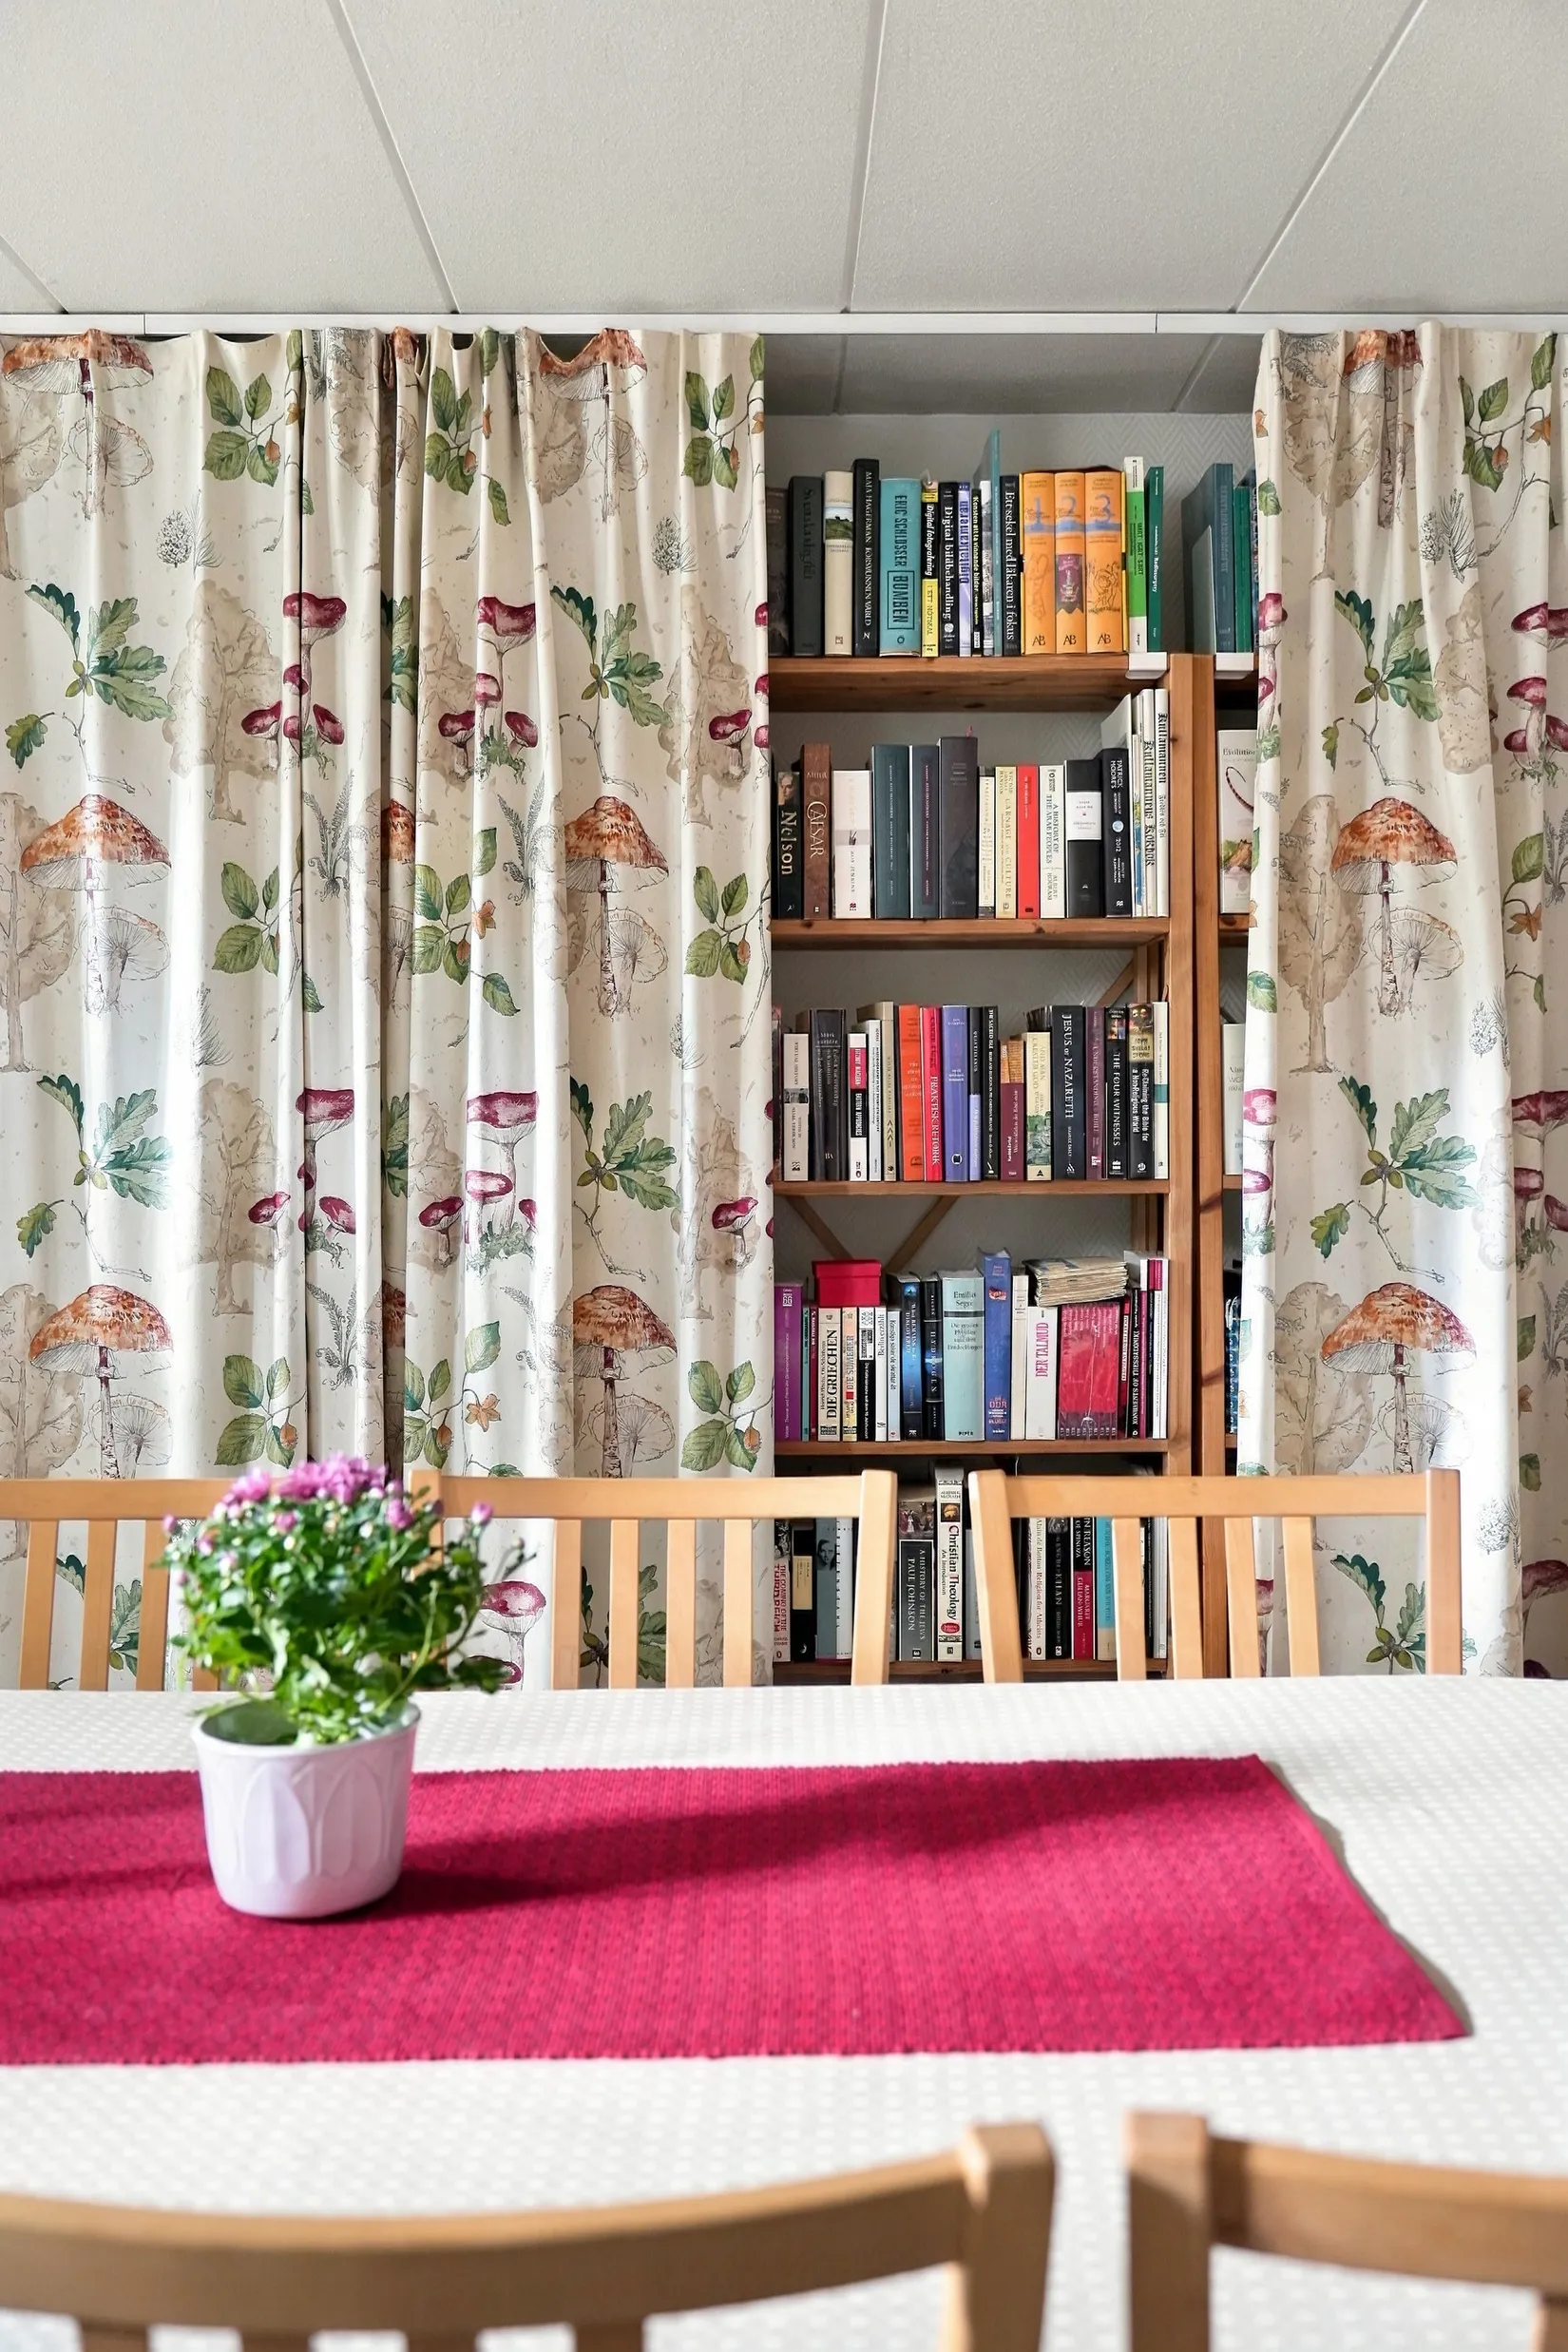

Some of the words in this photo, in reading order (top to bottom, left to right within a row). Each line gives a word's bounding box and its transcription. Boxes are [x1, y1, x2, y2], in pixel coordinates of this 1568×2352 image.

[894, 495, 908, 514] ERIC
[925, 504, 935, 528] Digital
[1004, 491, 1016, 507] Ett
[864, 495, 872, 543] HAGERMAN
[942, 507, 953, 541] Digital
[1004, 509, 1016, 536] sekel
[894, 518, 908, 566] SCHLOSSER
[925, 529, 934, 576] fotografering
[959, 501, 970, 583] Digitalkameran
[1005, 539, 1016, 564] med
[893, 576, 908, 622] BOMBEN
[942, 544, 953, 620] bildbehandling
[1005, 564, 1017, 602] läkaren
[1006, 611, 1017, 640] fokus
[1157, 713, 1167, 784] Kullamannen
[780, 811, 797, 875] Nelson
[807, 801, 828, 859] CAESAR
[1053, 843, 1059, 853] OF
[1061, 1014, 1072, 1045] JESUS
[929, 1076, 939, 1121] PRAKTISK
[1063, 1058, 1074, 1119] NAZARETH
[1131, 1075, 1139, 1114] Non-Religious
[931, 1124, 940, 1165] RETORIK
[953, 1291, 977, 1299] Emilio
[846, 1335, 854, 1376] SUMERER
[1035, 1322, 1048, 1358] TALMUD
[826, 1329, 837, 1395] GRIECHEN
[1035, 1359, 1048, 1377] DER
[1132, 1378, 1139, 1386] OF
[826, 1396, 837, 1419] DIE
[1036, 1537, 1042, 1546] de
[1075, 1520, 1080, 1529] OF
[941, 1550, 947, 1558] An
[948, 1525, 960, 1572] Christian
[919, 1592, 926, 1601] OF
[947, 1574, 960, 1620] Theology
[1034, 1572, 1043, 1600] Religion
[780, 1609, 786, 1617] OF
